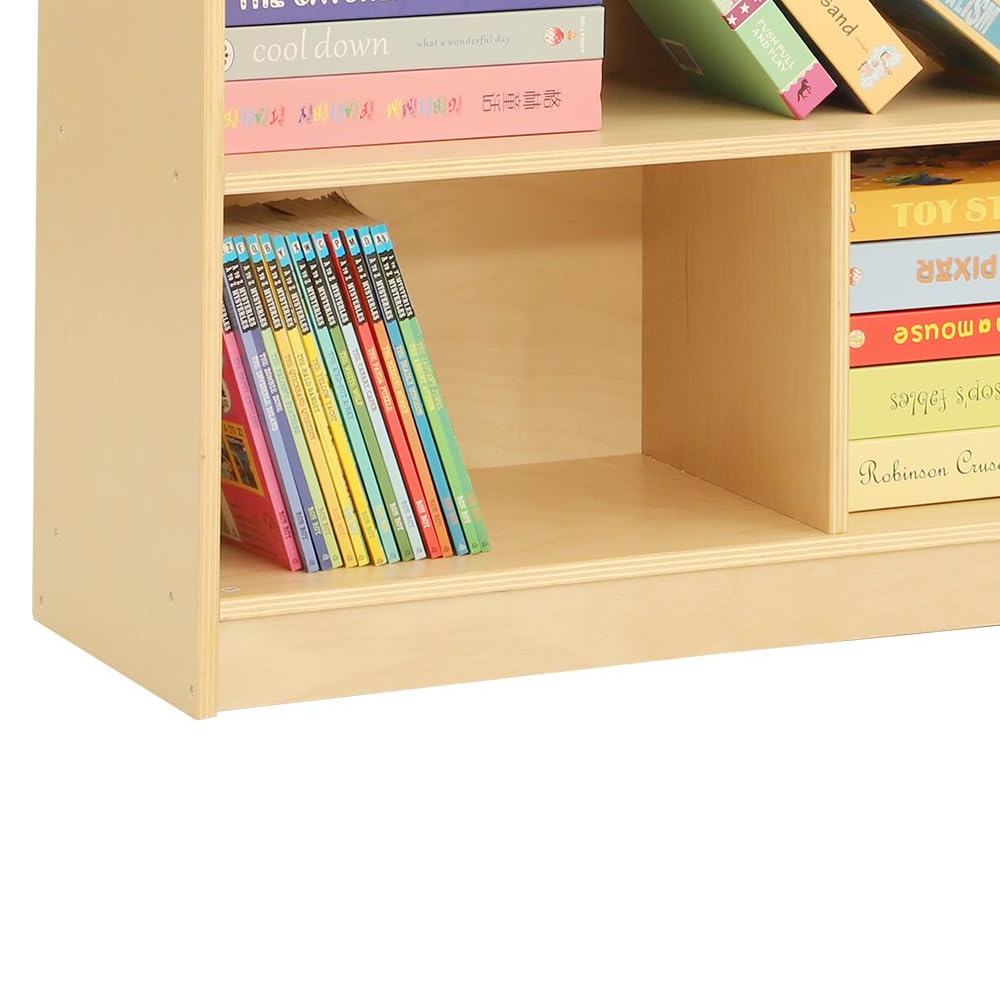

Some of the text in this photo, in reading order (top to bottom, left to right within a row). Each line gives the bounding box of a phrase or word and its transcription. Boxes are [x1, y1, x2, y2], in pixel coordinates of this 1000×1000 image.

[252, 26, 391, 63] cool down
[416, 38, 437, 48] what
[447, 35, 492, 47] wonderful
[494, 34, 512, 47] day
[753, 28, 789, 73] AND PLAY
[757, 18, 795, 70] PUSH PULL
[482, 88, 563, 113] 格林童话
[892, 199, 959, 228] TOY
[916, 254, 998, 284] PIXAR
[893, 319, 974, 345] mouse
[978, 318, 992, 334] a
[368, 347, 378, 360] THE
[259, 351, 283, 412] THE ZOMBIE ZONE
[372, 361, 385, 385] PANDA
[890, 388, 947, 416] fables
[859, 459, 949, 486] Robinson
[415, 499, 430, 528] RON ROY
